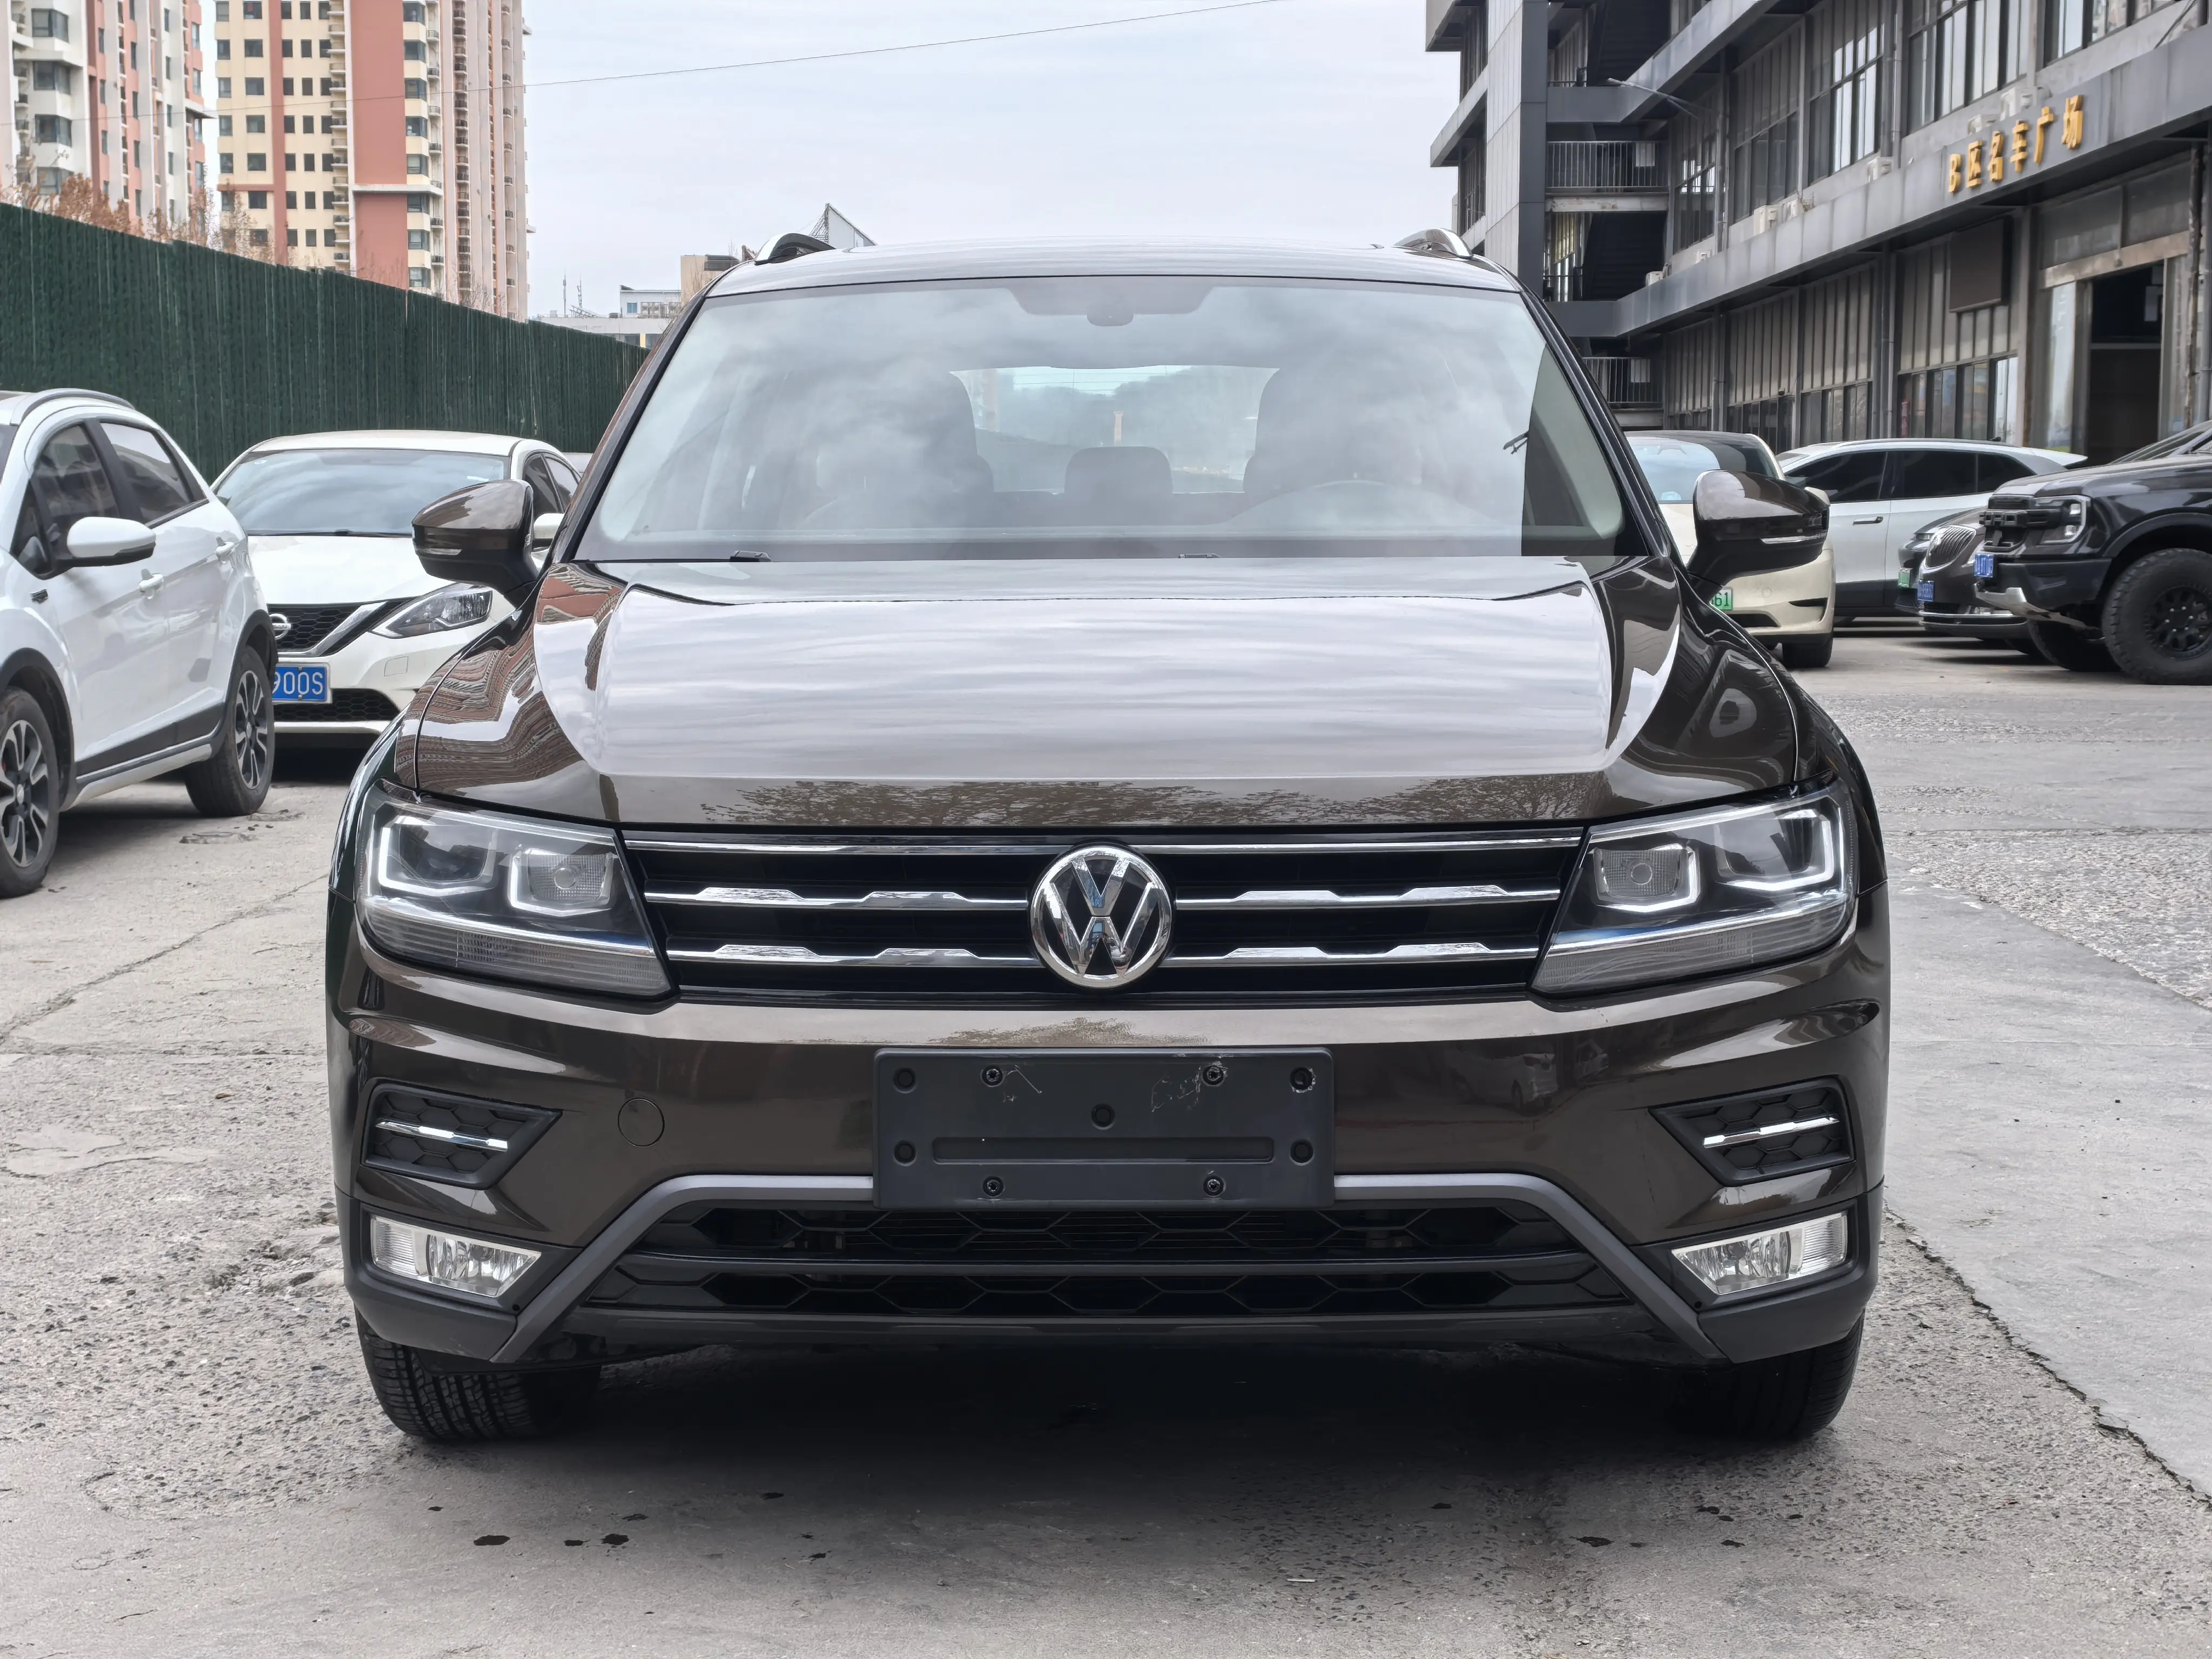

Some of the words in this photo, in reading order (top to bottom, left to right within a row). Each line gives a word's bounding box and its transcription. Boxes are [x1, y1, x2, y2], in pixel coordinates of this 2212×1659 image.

[1948, 95, 2084, 194] B区名车广场
[1711, 591, 1729, 606] 61
